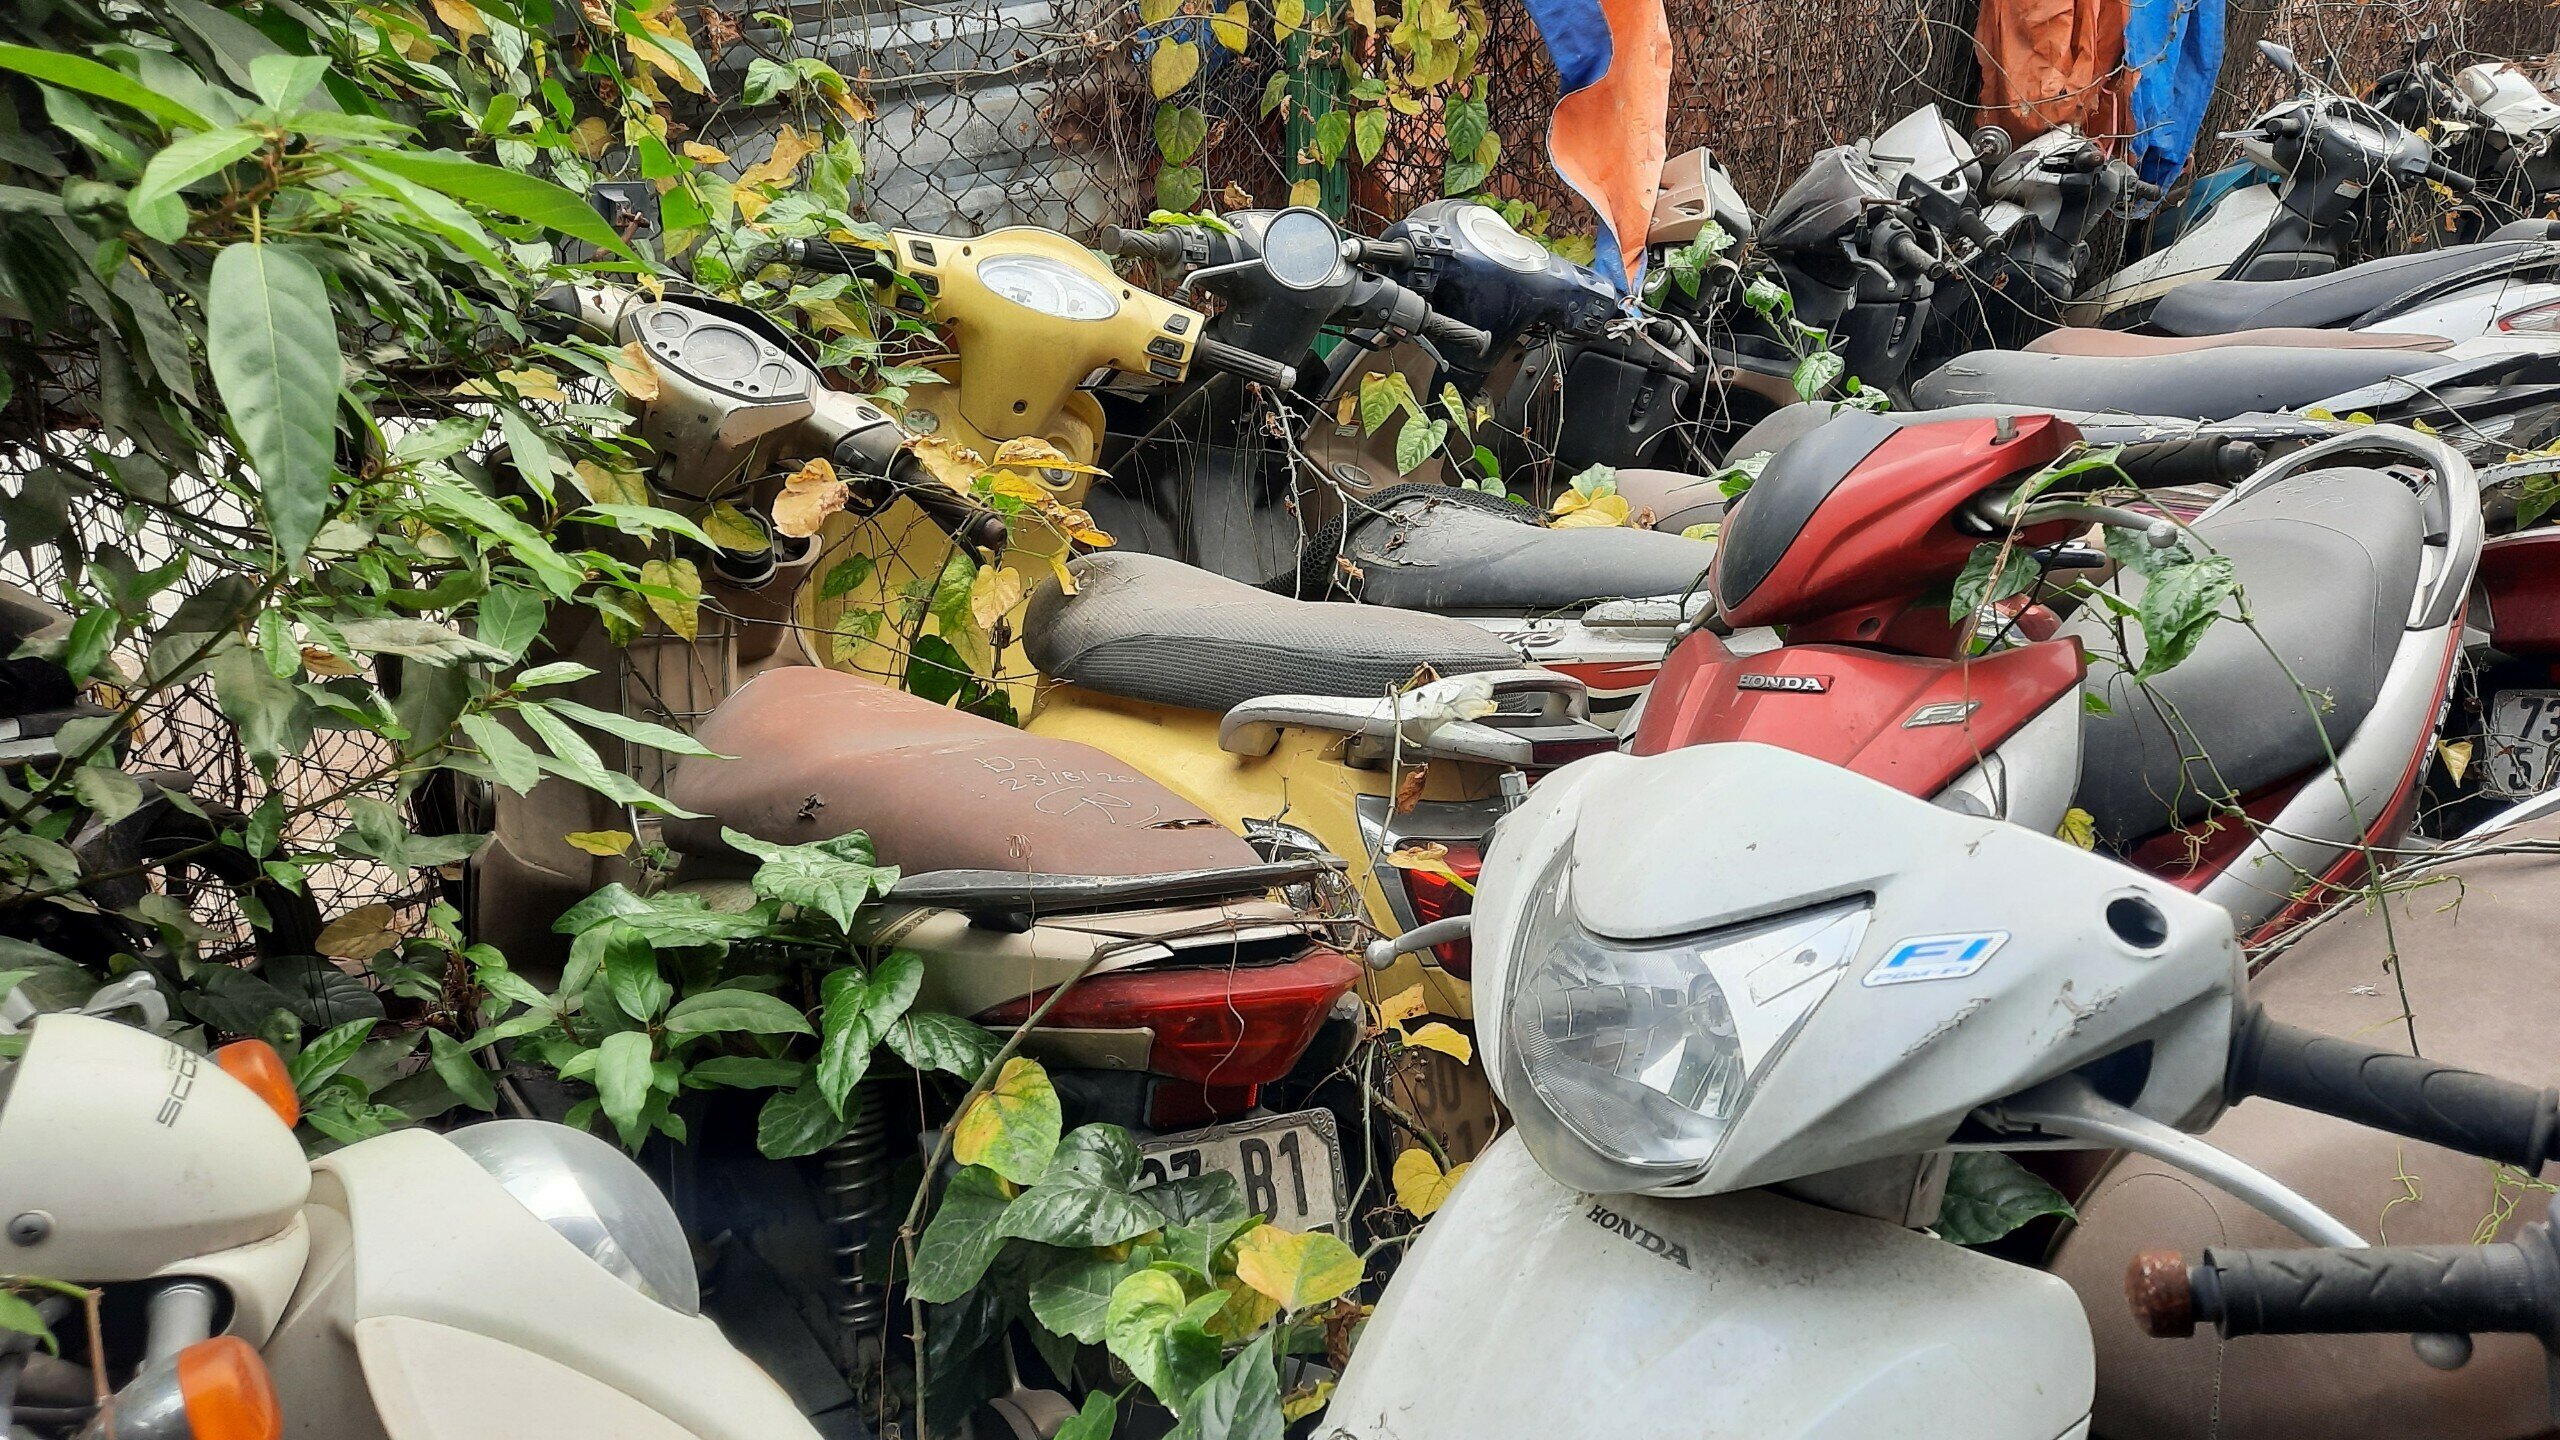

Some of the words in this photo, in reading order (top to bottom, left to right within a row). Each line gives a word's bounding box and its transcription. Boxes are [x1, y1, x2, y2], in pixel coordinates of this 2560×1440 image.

[1738, 673, 1825, 692] HONDA
[2519, 697, 2560, 742] 73
[1886, 937, 1994, 968] FI
[1239, 1130, 1309, 1225] B1
[1586, 1204, 1692, 1271] HONDA
